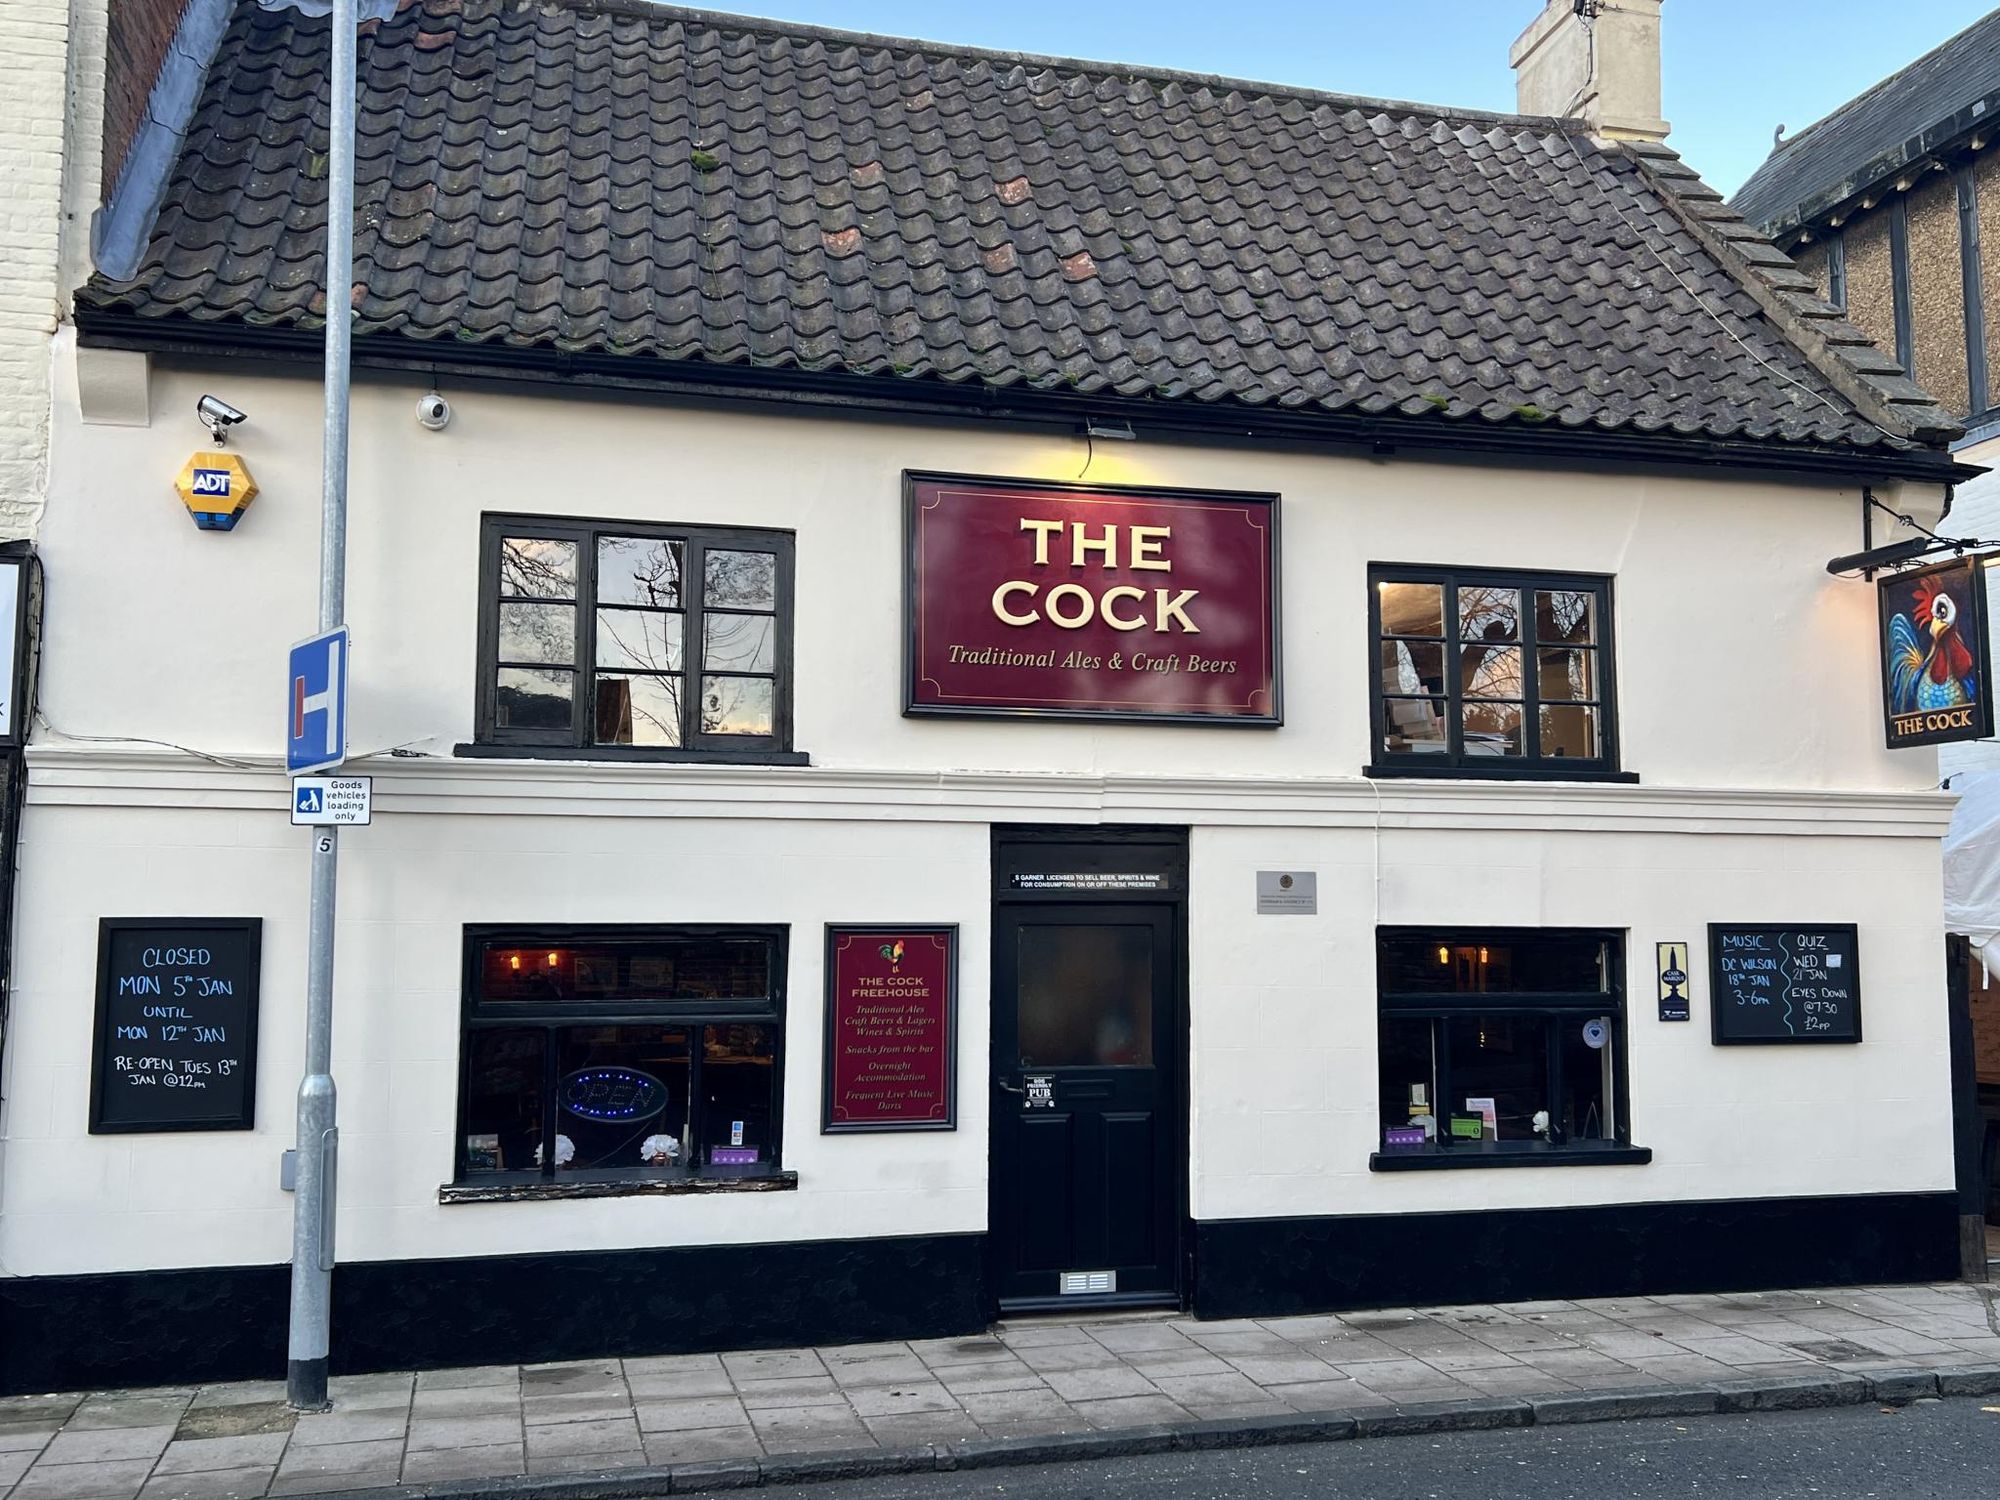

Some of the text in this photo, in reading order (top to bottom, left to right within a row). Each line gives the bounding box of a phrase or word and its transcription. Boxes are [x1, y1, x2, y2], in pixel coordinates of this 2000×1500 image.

[193, 473, 232, 492] ADT
[1020, 518, 1172, 573] THE
[992, 580, 1201, 633] COCK
[949, 645, 1237, 675] Traditional Ales & Craft Beers
[1894, 709, 1973, 736] THE COCK
[331, 780, 362, 789] Goods
[326, 791, 366, 800] vehicles
[327, 801, 364, 811] loading
[335, 812, 356, 821] only
[320, 837, 332, 853] 5
[1722, 935, 1764, 947] MUSIC
[1797, 934, 1827, 947] QUIZ
[143, 948, 211, 968] CLOSED
[1721, 957, 1777, 971] DC WILSON
[1793, 954, 1818, 968] WED
[1748, 974, 1770, 987] JAN
[1805, 969, 1828, 981] JAN
[119, 975, 161, 996] MON
[197, 977, 233, 996] JAN
[858, 977, 924, 986] THE COCK
[852, 988, 930, 997] FREEHOUSE
[1792, 987, 1817, 999] EYES
[143, 1006, 193, 1018] UNTIL
[856, 1004, 925, 1014] Traditional Ales
[845, 1016, 867, 1026] Craft
[870, 1016, 894, 1025] Beers
[907, 1016, 935, 1026] Lagers
[117, 1025, 226, 1043] MON 12TH JAN
[856, 1027, 883, 1036] Wines
[896, 1027, 924, 1037] Spirits
[845, 1044, 934, 1055] Snacks from the bar
[114, 1055, 173, 1071] RE-OPEN
[179, 1060, 211, 1075] TUES
[868, 1061, 912, 1072] Overnight
[128, 1074, 156, 1086] JAN
[855, 1073, 926, 1082] Accommodation
[567, 1083, 656, 1108] OPEN
[845, 1089, 934, 1100] Frequent Live Music
[1029, 1088, 1051, 1097] PUB
[877, 1101, 902, 1110] Darts
